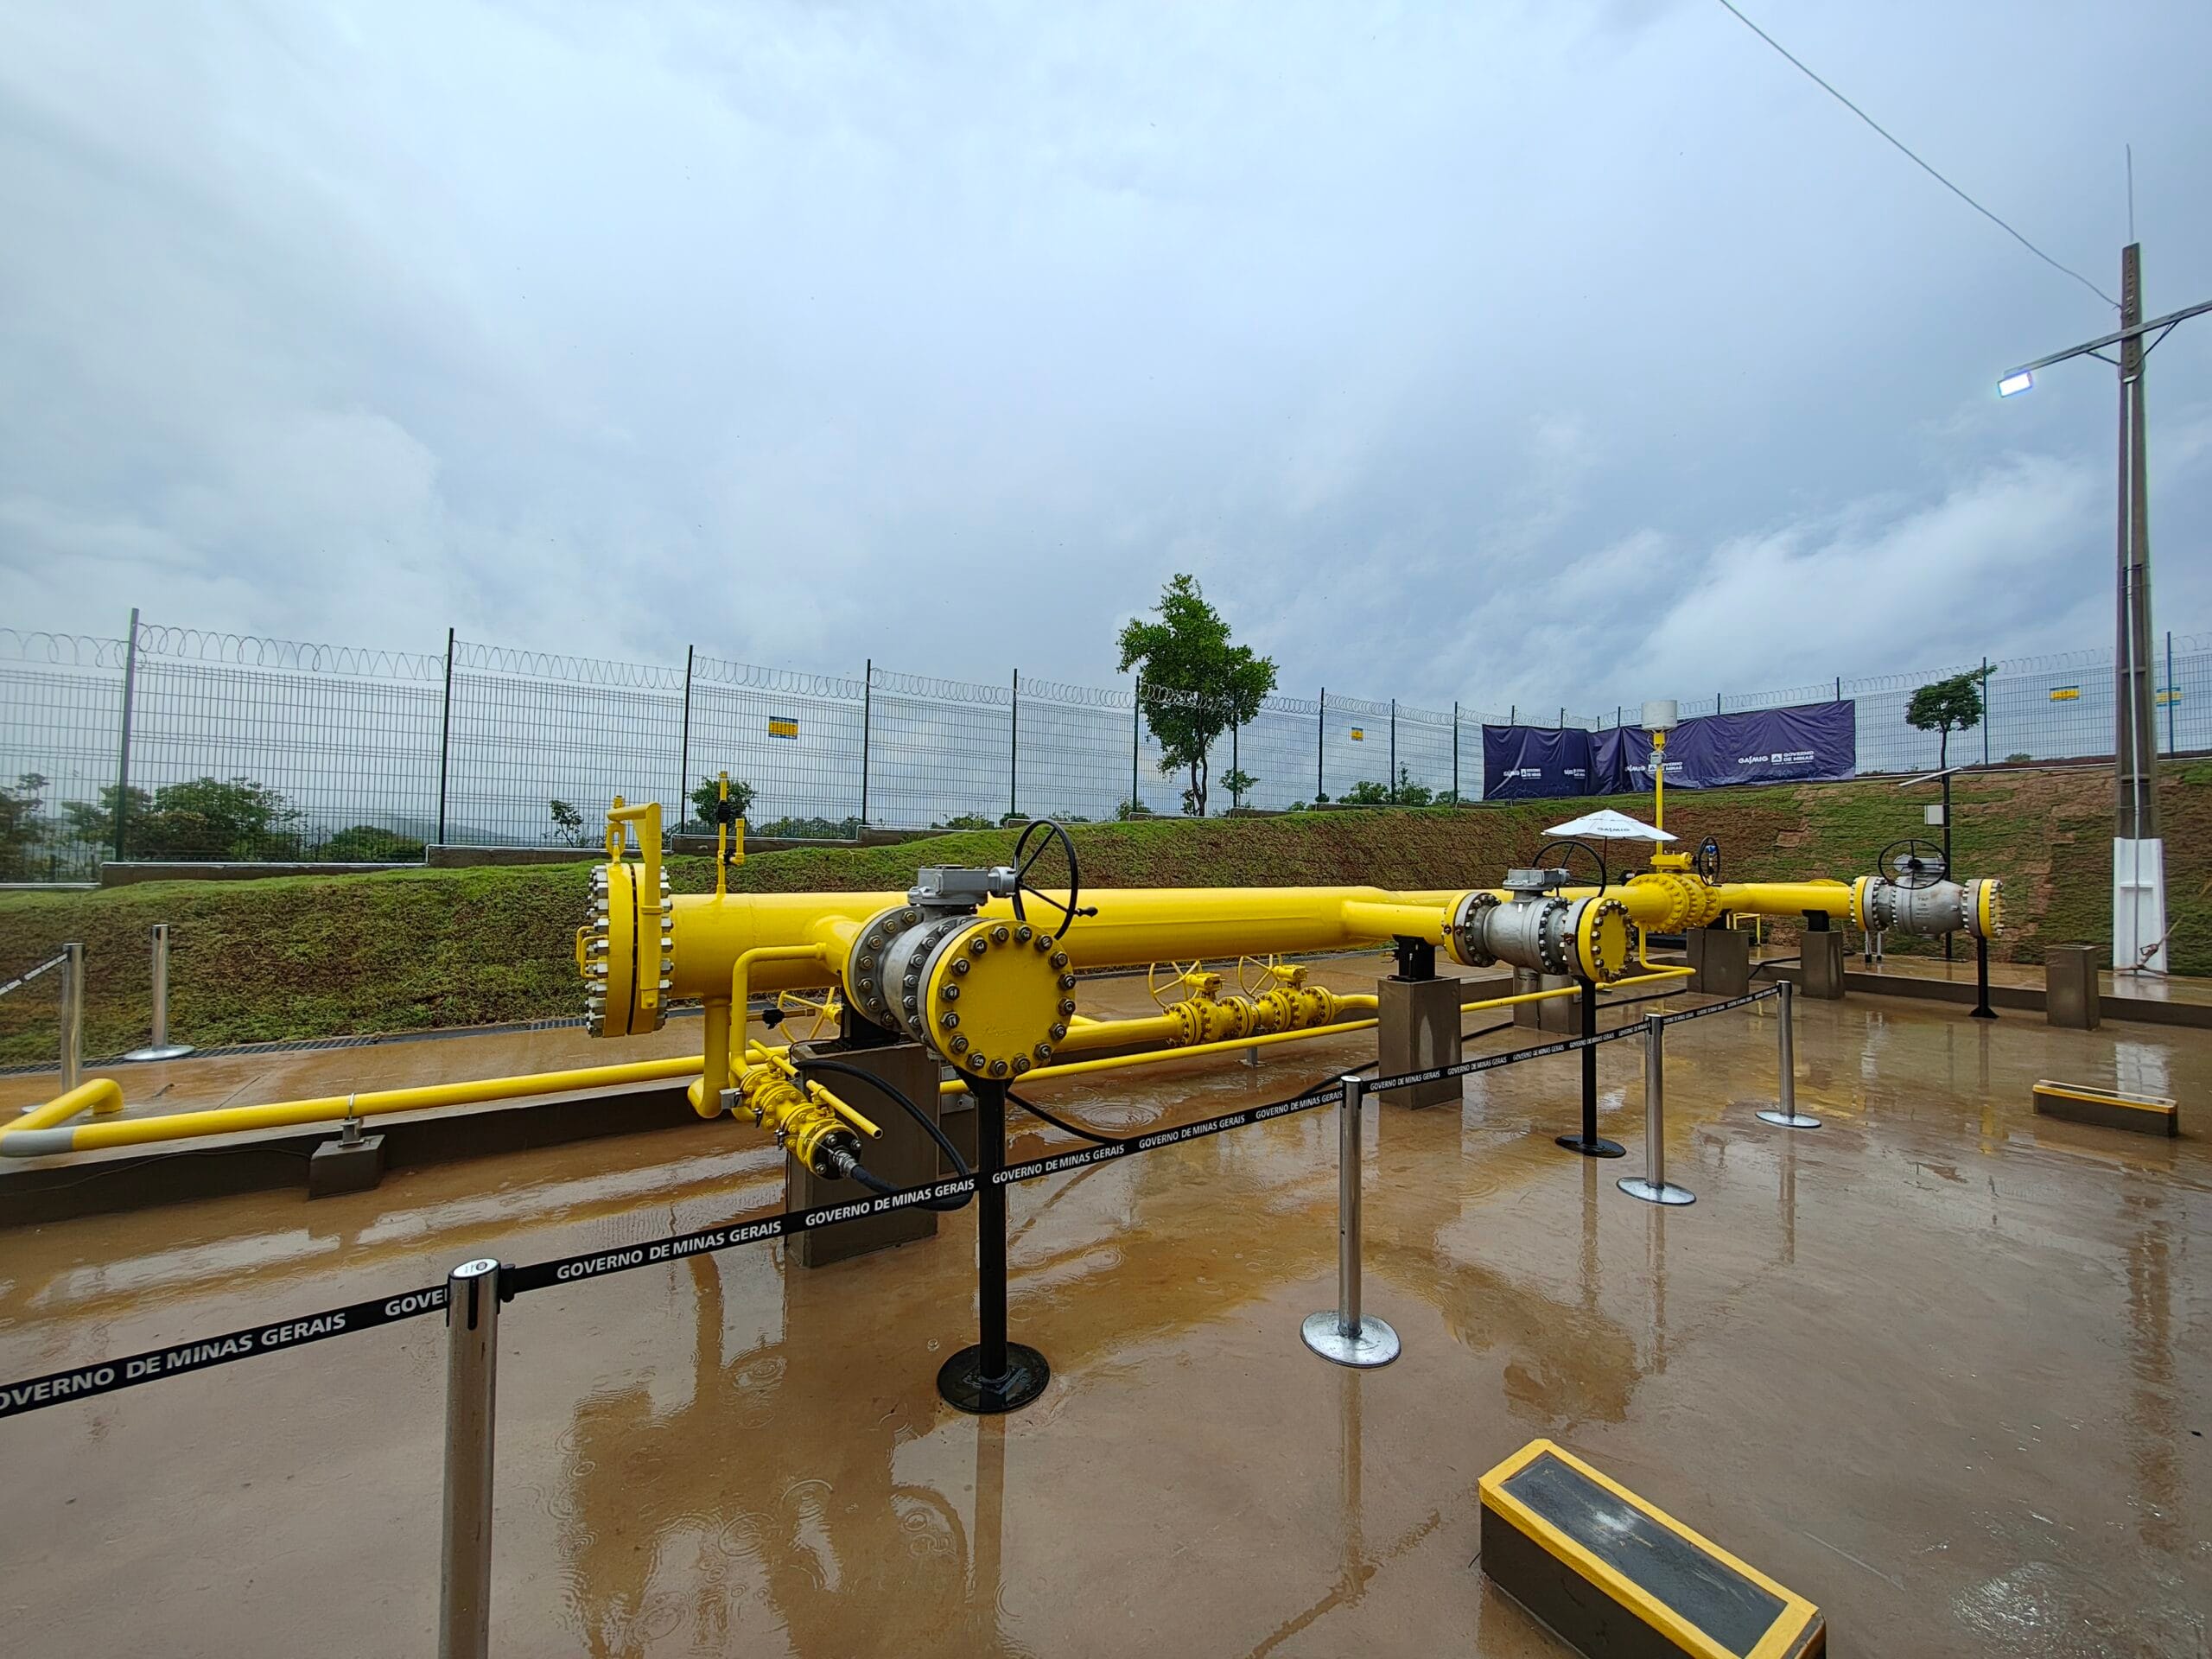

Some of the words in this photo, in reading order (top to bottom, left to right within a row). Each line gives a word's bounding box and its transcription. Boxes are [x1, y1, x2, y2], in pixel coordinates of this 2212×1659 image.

[1370, 1079, 1396, 1090] GOVERNO
[1422, 1071, 1440, 1080] GERAIS
[1447, 1065, 1470, 1075] GOVERNO
[1255, 1104, 1288, 1119] GOVERNO
[1290, 1102, 1299, 1110] DE
[1299, 1096, 1320, 1107] MINAS
[1321, 1091, 1343, 1102] GERAIS
[1139, 1132, 1179, 1148] GOVERNO
[1181, 1128, 1192, 1137] DE
[1192, 1122, 1217, 1134] MINAS
[1218, 1116, 1244, 1128] GERAIS
[992, 1164, 1042, 1183] GOVERNO
[1046, 1160, 1058, 1171] DE
[1059, 1153, 1090, 1167] MINAS
[1092, 1145, 1125, 1159] GERAIS
[805, 1203, 870, 1225] GOVERNO
[874, 1198, 890, 1211] DE
[892, 1189, 931, 1206] MINAS
[934, 1179, 975, 1196] GERAIS
[556, 1250, 643, 1278] GOVERNO
[649, 1244, 671, 1259] DE
[672, 1233, 725, 1254] MINAS
[729, 1221, 781, 1242] GERAIS
[385, 1289, 448, 1315] GOVE
[0, 1369, 115, 1409] OVERNO
[126, 1357, 161, 1378] DE
[166, 1335, 252, 1369] MINAS
[261, 1313, 346, 1344] GERAIS
